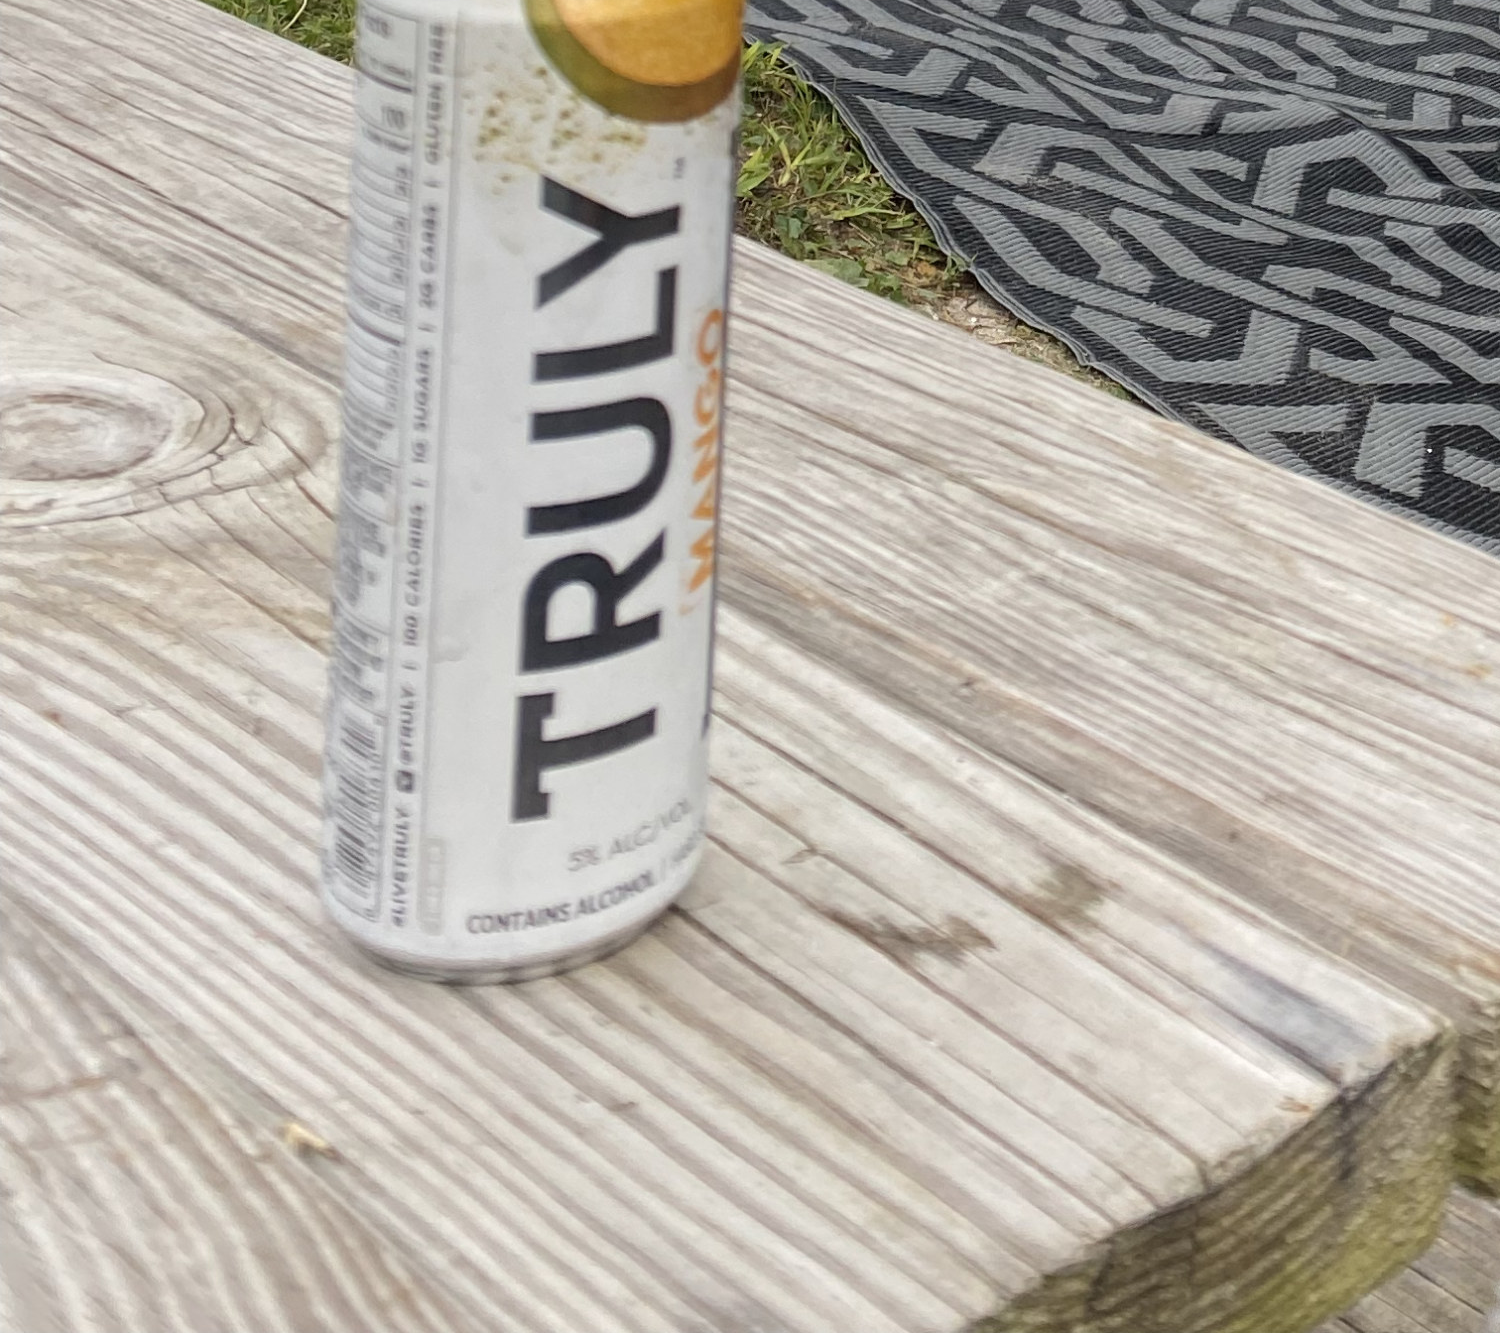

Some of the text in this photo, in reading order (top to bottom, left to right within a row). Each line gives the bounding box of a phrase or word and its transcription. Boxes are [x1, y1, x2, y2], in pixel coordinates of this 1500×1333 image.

[428, 23, 447, 75] FREE
[425, 85, 444, 165] GLUTEN
[420, 203, 440, 274] CARBS
[418, 283, 437, 309] 2G
[413, 346, 433, 431] SUGARS
[688, 309, 724, 593] MANGO
[512, 175, 681, 822] TRULY
[404, 501, 426, 607] CALORIES
[403, 615, 419, 647] 100
[466, 869, 655, 934] CONTAINS ALCOHOL
